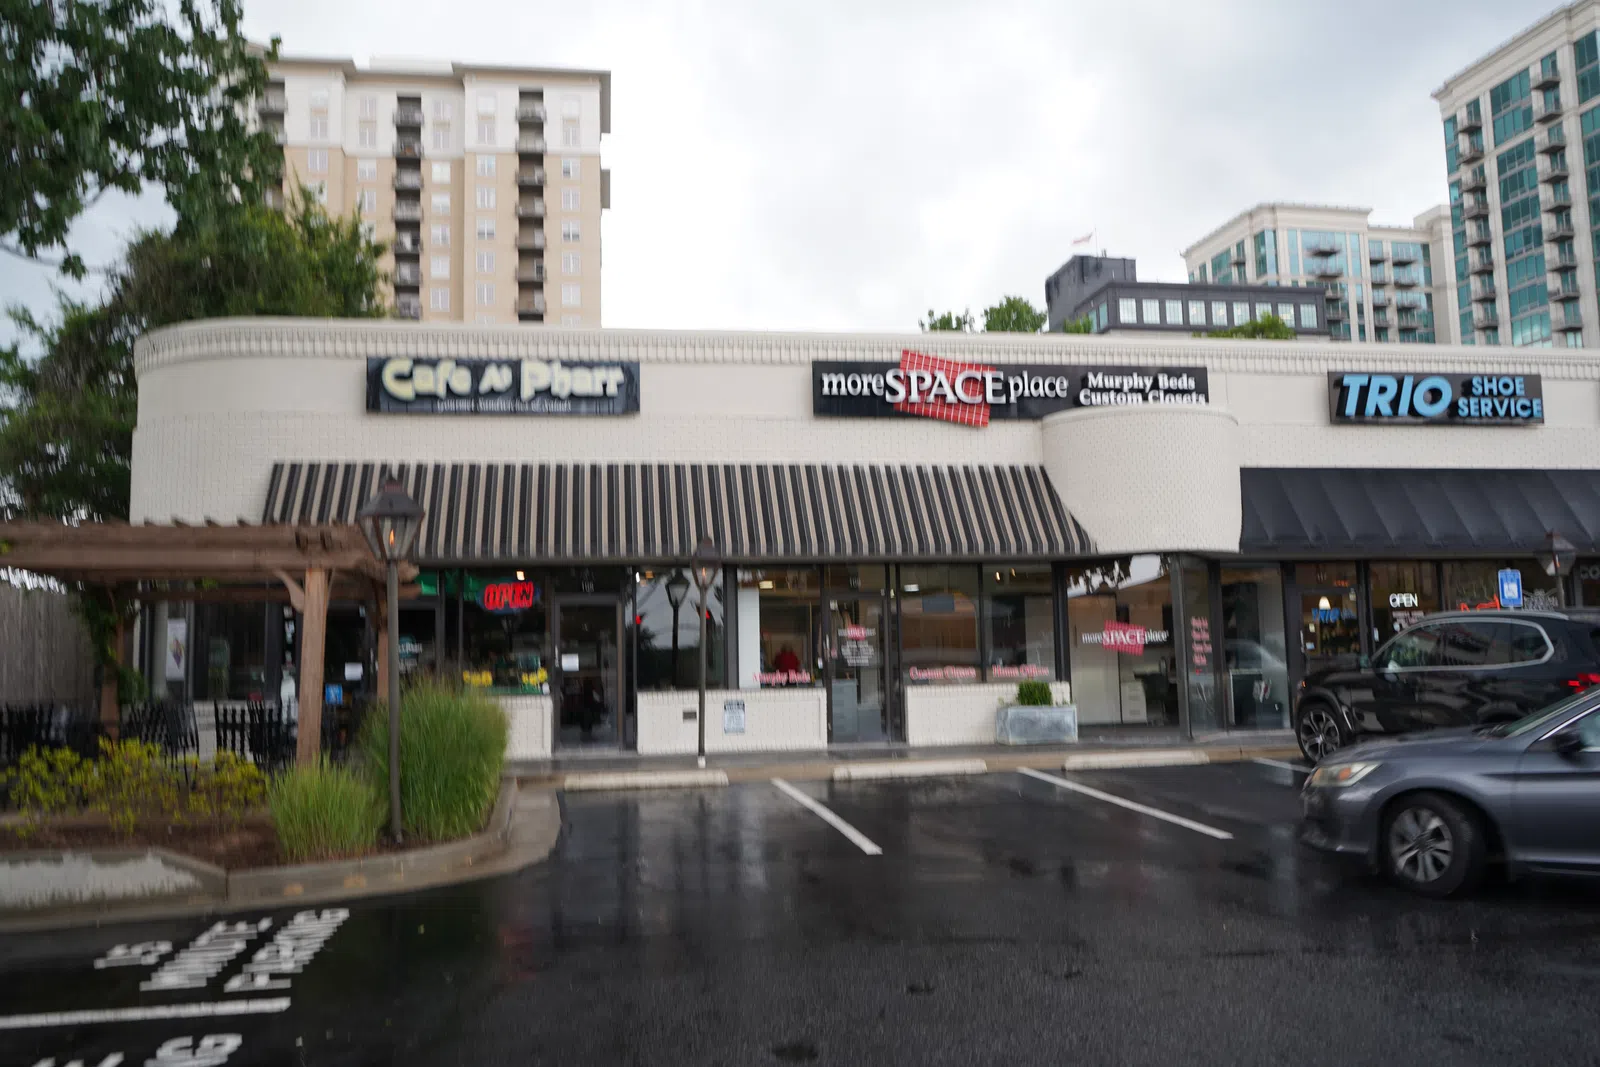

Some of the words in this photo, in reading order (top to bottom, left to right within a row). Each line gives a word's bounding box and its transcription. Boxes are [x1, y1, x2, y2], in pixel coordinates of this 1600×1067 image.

[520, 358, 625, 401] Pharr
[821, 371, 885, 397] more
[885, 368, 1007, 404] SPACE
[1008, 370, 1069, 403] place
[1087, 372, 1153, 393] Murphy
[1157, 373, 1196, 390] Beds
[1471, 376, 1525, 397] SHOE
[1080, 388, 1143, 406] Custom
[1148, 389, 1206, 405] Closets
[1342, 374, 1452, 418] TRIO
[1457, 397, 1543, 419] SERVICE
[484, 582, 534, 610] OPEN
[1389, 593, 1418, 608] OPEN
[1081, 630, 1103, 644] more
[1102, 628, 1145, 646] SPACE
[1144, 628, 1168, 644] place
